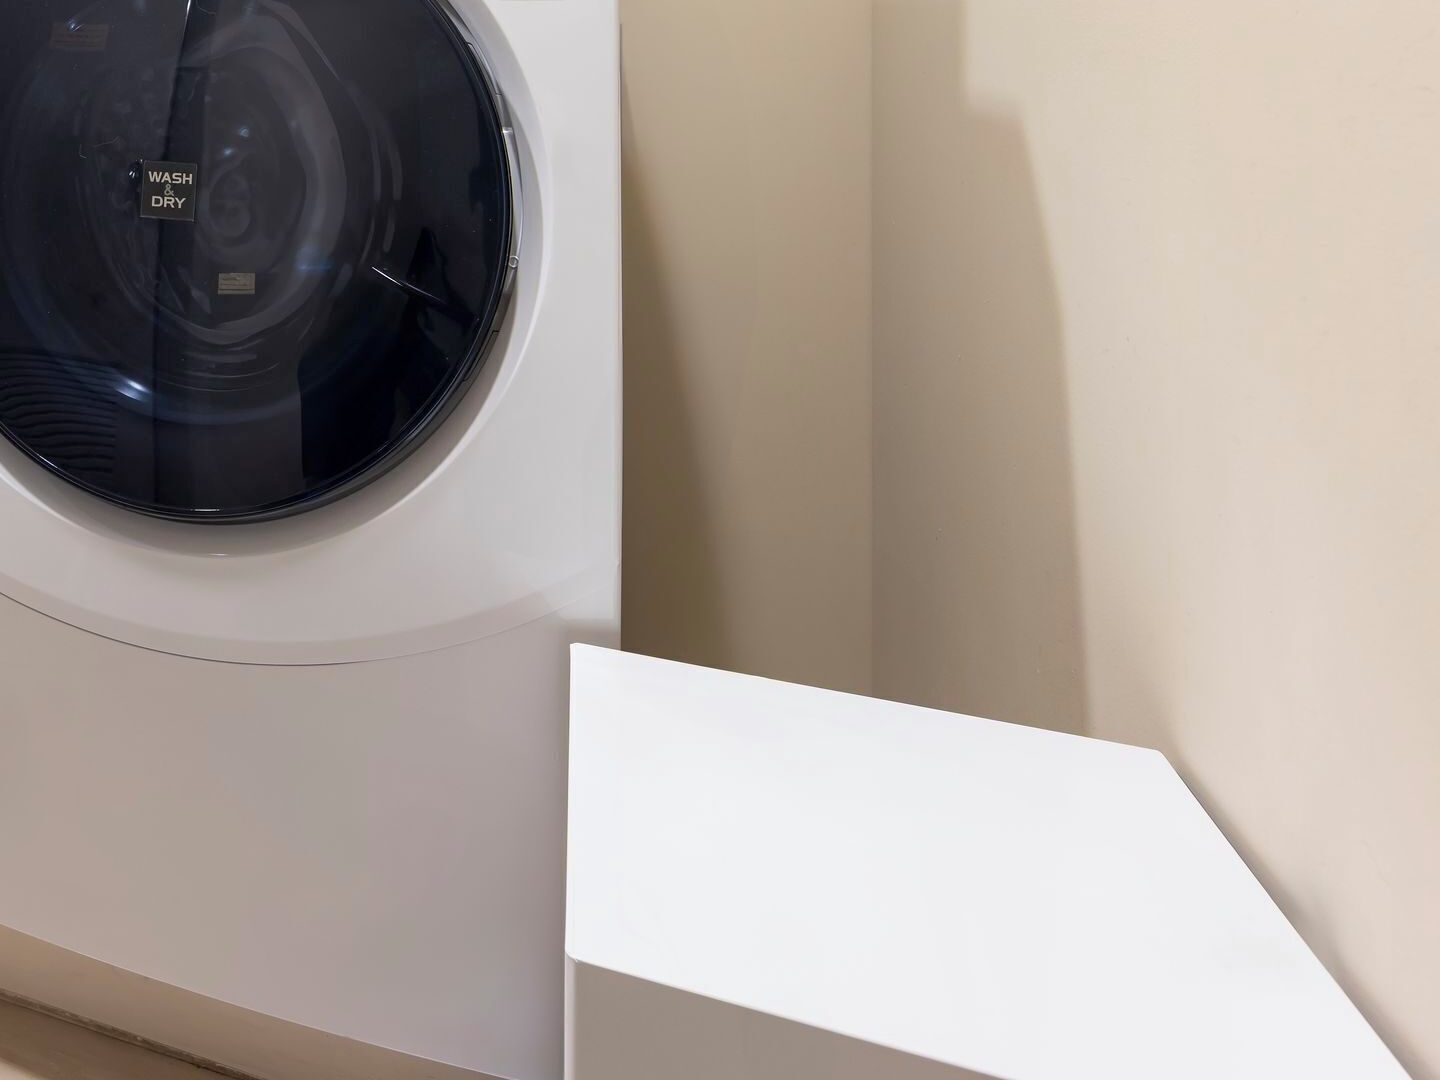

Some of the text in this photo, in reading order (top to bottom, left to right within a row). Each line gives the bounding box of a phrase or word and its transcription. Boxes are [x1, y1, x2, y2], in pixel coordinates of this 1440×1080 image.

[149, 171, 192, 184] WASH
[164, 184, 174, 196] &
[152, 196, 186, 208] DRY
